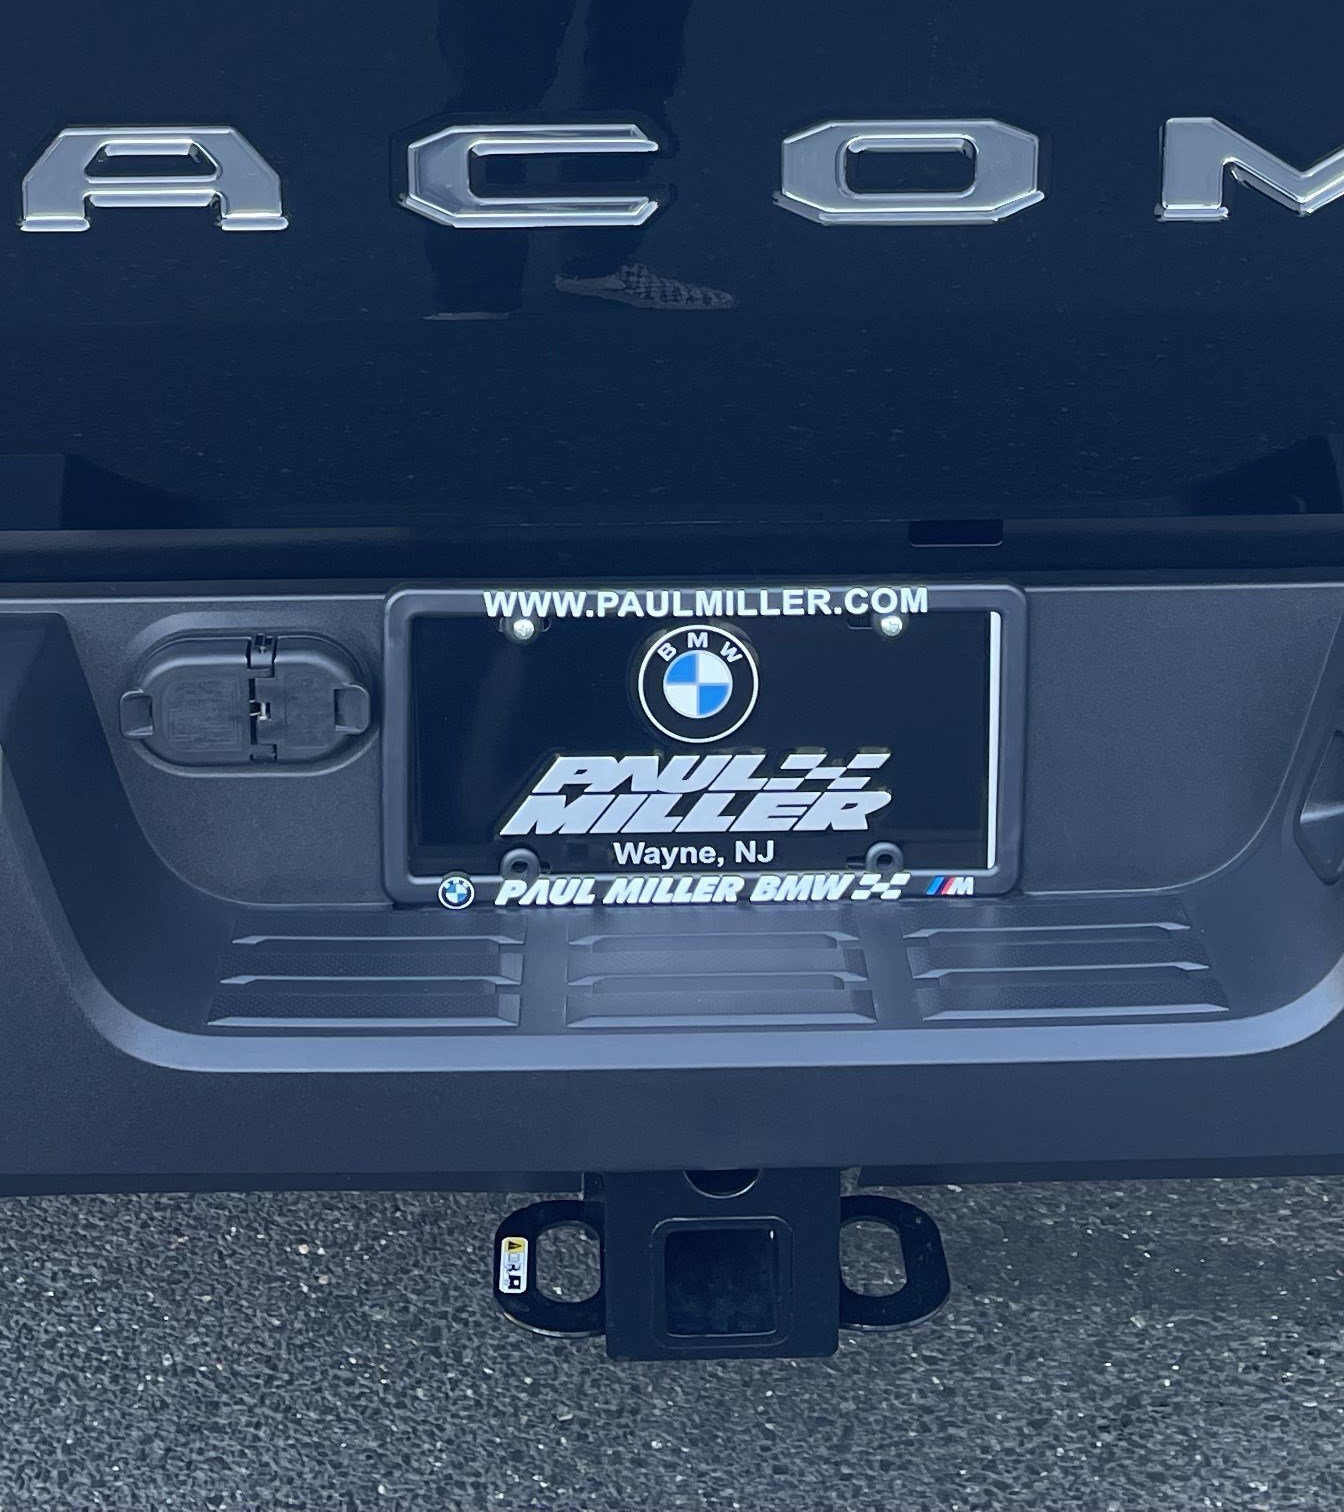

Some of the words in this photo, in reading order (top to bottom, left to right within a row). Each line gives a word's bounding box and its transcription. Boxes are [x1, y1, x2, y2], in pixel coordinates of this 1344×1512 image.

[483, 587, 929, 618] WWW.PAULMILLER.COM
[657, 631, 743, 663] BMW
[531, 754, 767, 793] PAUL
[499, 791, 892, 836] MILLER
[613, 841, 725, 871] Wayne,
[735, 840, 775, 864] NJ
[494, 877, 595, 906] PAUL
[602, 875, 745, 904] MILLER
[749, 873, 855, 901] BMW
